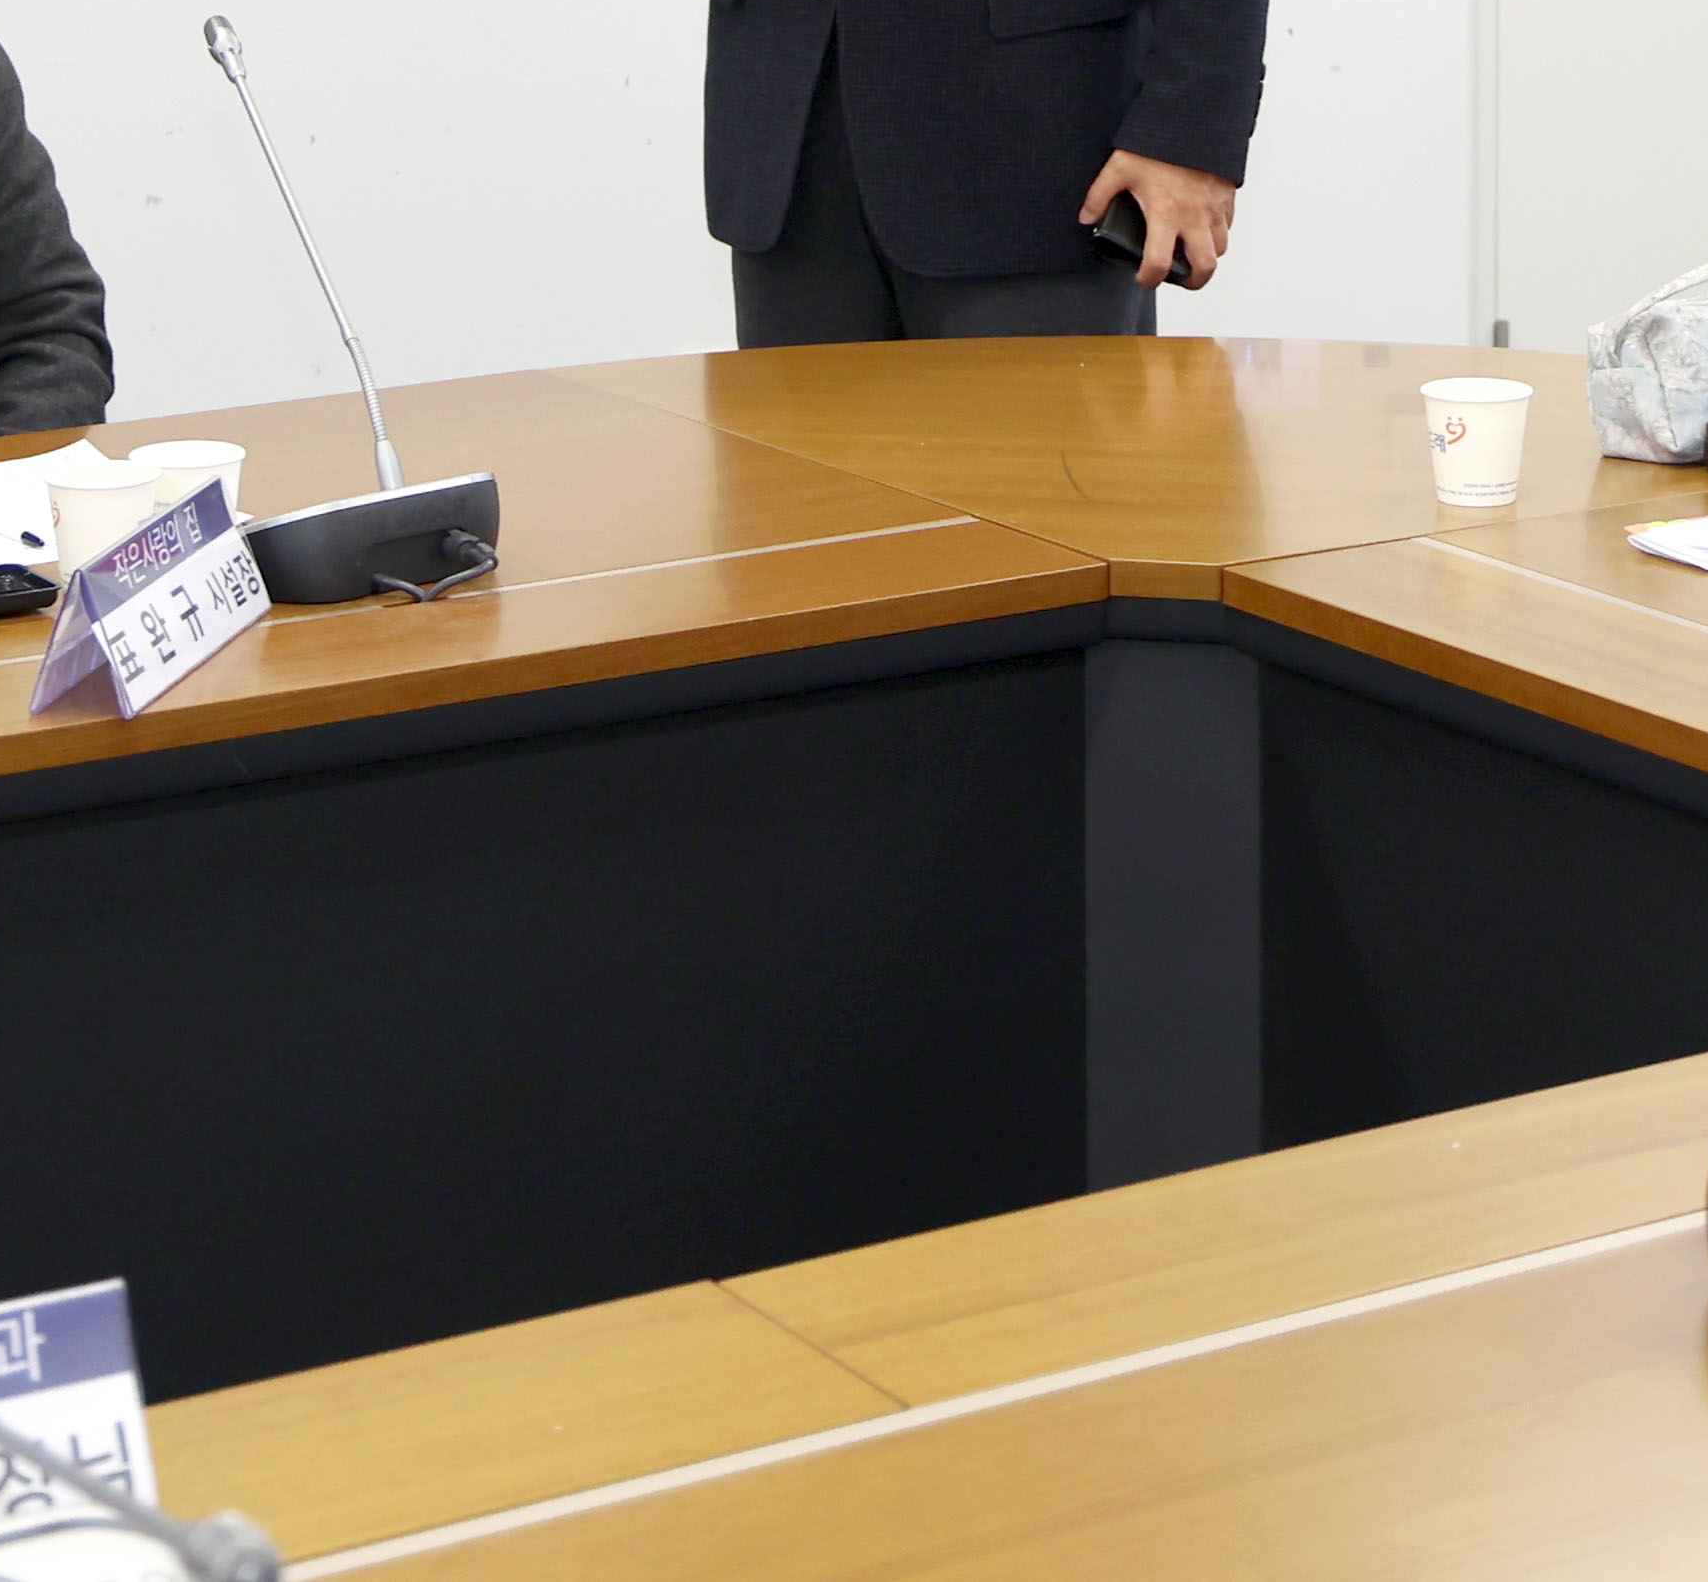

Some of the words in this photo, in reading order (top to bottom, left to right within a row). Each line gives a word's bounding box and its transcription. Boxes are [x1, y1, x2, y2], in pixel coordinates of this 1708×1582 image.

[112, 513, 185, 589] 작은사랑의
[182, 500, 203, 544] 집
[205, 549, 261, 615] 시설장
